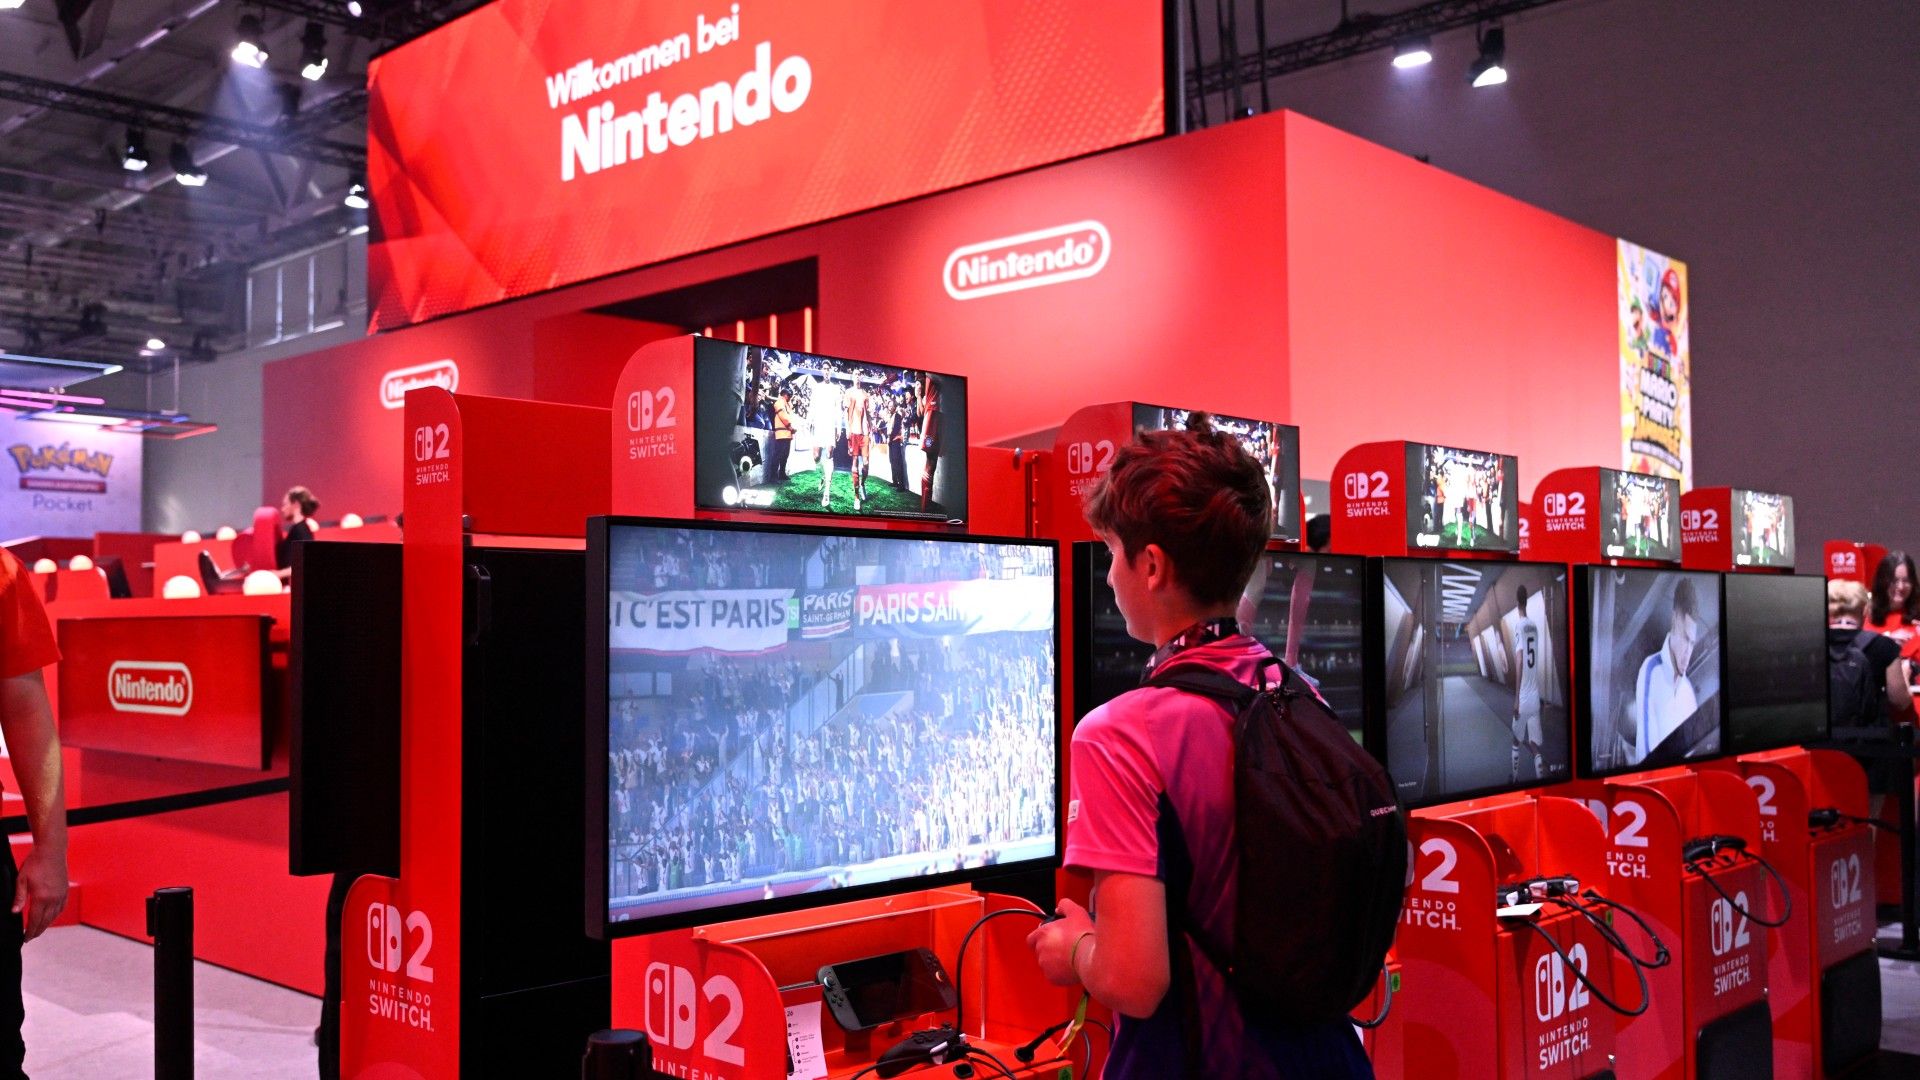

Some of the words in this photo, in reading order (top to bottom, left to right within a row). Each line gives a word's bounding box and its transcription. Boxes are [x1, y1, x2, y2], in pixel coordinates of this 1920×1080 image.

[545, 33, 691, 109] Willkommen
[697, 3, 740, 54] bei
[561, 41, 812, 182] Nintendo
[957, 237, 1095, 287] Nintendo
[656, 386, 677, 428] 2
[435, 423, 450, 459] 2
[629, 433, 675, 446] NINTENDO
[1095, 439, 1115, 472] 2
[416, 463, 449, 474] NINTENDO
[1370, 470, 1390, 498] 2
[33, 494, 93, 512] Pocket
[1567, 491, 1586, 515] 2
[1702, 508, 1719, 529] 2
[630, 599, 706, 629] C'EST
[711, 598, 786, 628] PARIS
[803, 588, 854, 611] PARIS
[859, 592, 919, 625] PARIS
[1526, 637, 1535, 668] 5
[115, 672, 185, 704] Nintendo
[1612, 800, 1648, 847] 2
[1419, 838, 1459, 893] 2
[1734, 890, 1750, 948] 2
[405, 910, 434, 983] 2
[1567, 943, 1590, 1012] 2
[1713, 954, 1749, 975] NINTENDO
[369, 979, 431, 1007] NINTENDO
[702, 974, 745, 1067] 2
[1539, 1017, 1588, 1046] NINTENDO
